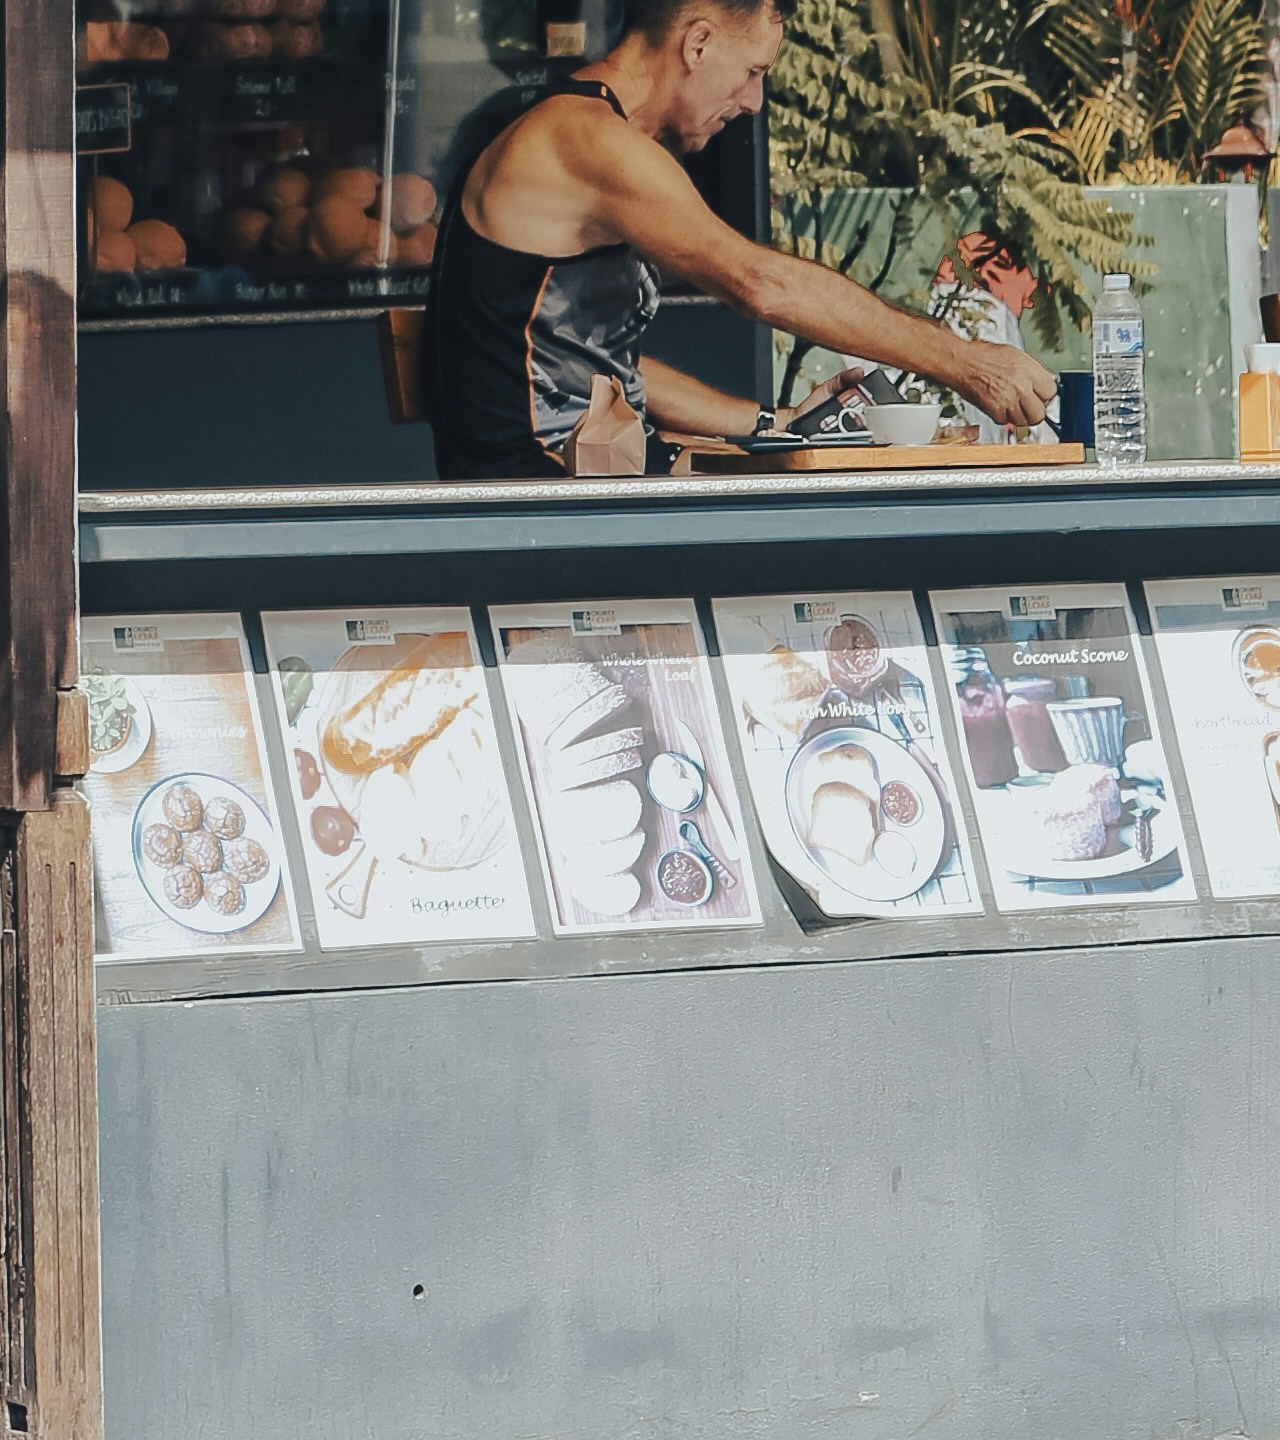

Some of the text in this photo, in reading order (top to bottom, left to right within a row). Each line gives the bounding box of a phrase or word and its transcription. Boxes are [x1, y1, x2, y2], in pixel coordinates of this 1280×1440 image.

[601, 652, 647, 668] Whole
[1013, 648, 1129, 666] Coconut Scone
[663, 667, 697, 684] Loaf
[827, 700, 876, 718] White
[1186, 712, 1273, 729] hortbread
[168, 722, 248, 740] rownies
[409, 894, 505, 918] Baguette
